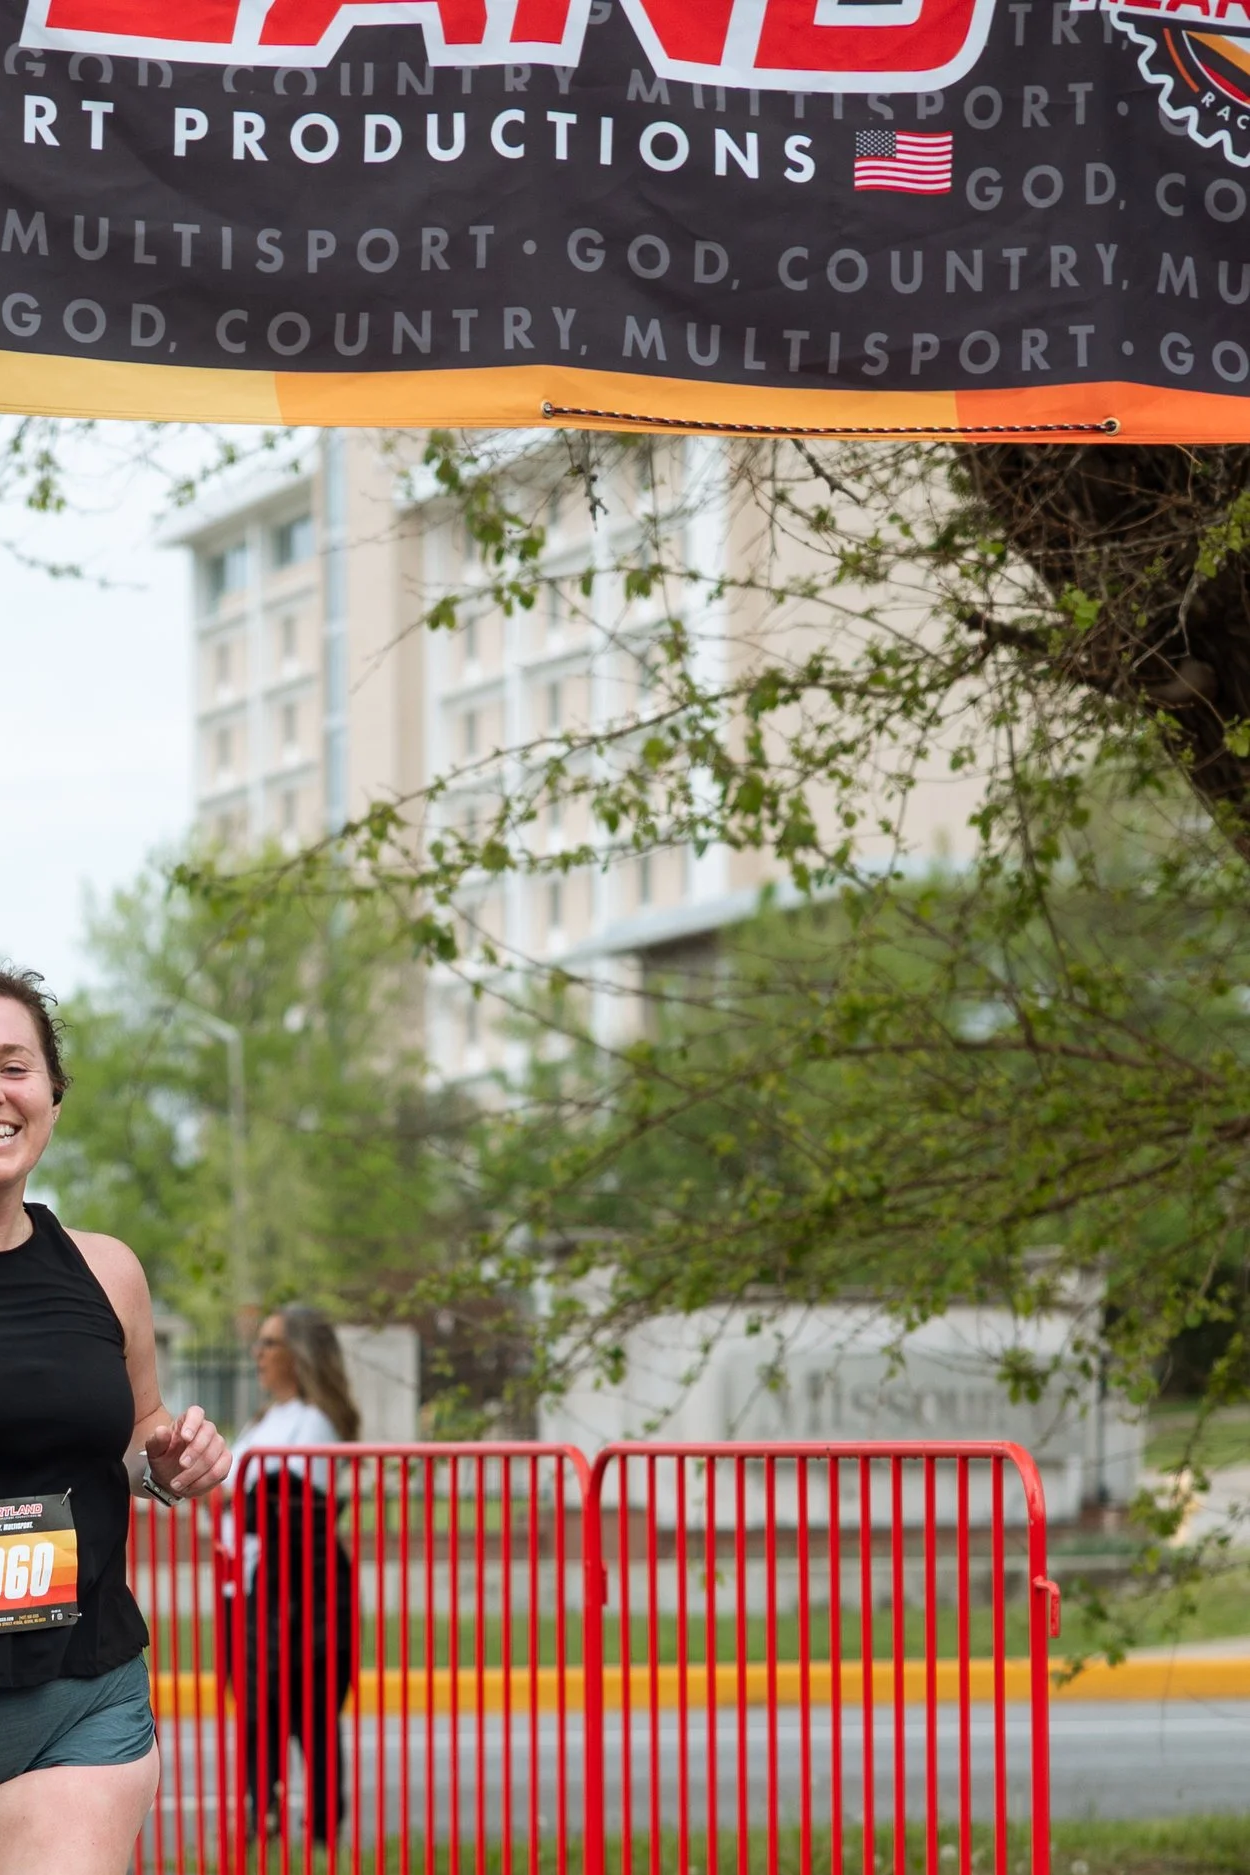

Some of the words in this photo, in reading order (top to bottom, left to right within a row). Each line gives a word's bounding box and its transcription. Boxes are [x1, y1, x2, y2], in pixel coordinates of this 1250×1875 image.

[173, 106, 817, 185] PRODUCTIONS
[966, 163, 1130, 211] GOD,
[1, 209, 495, 274] MULTISPORT
[567, 228, 741, 291] GOD,
[778, 241, 1130, 294] COUNTRY,
[1, 292, 178, 355] GOD,
[216, 307, 588, 356] COUNTRY,
[622, 315, 1096, 377] MULTISPORT
